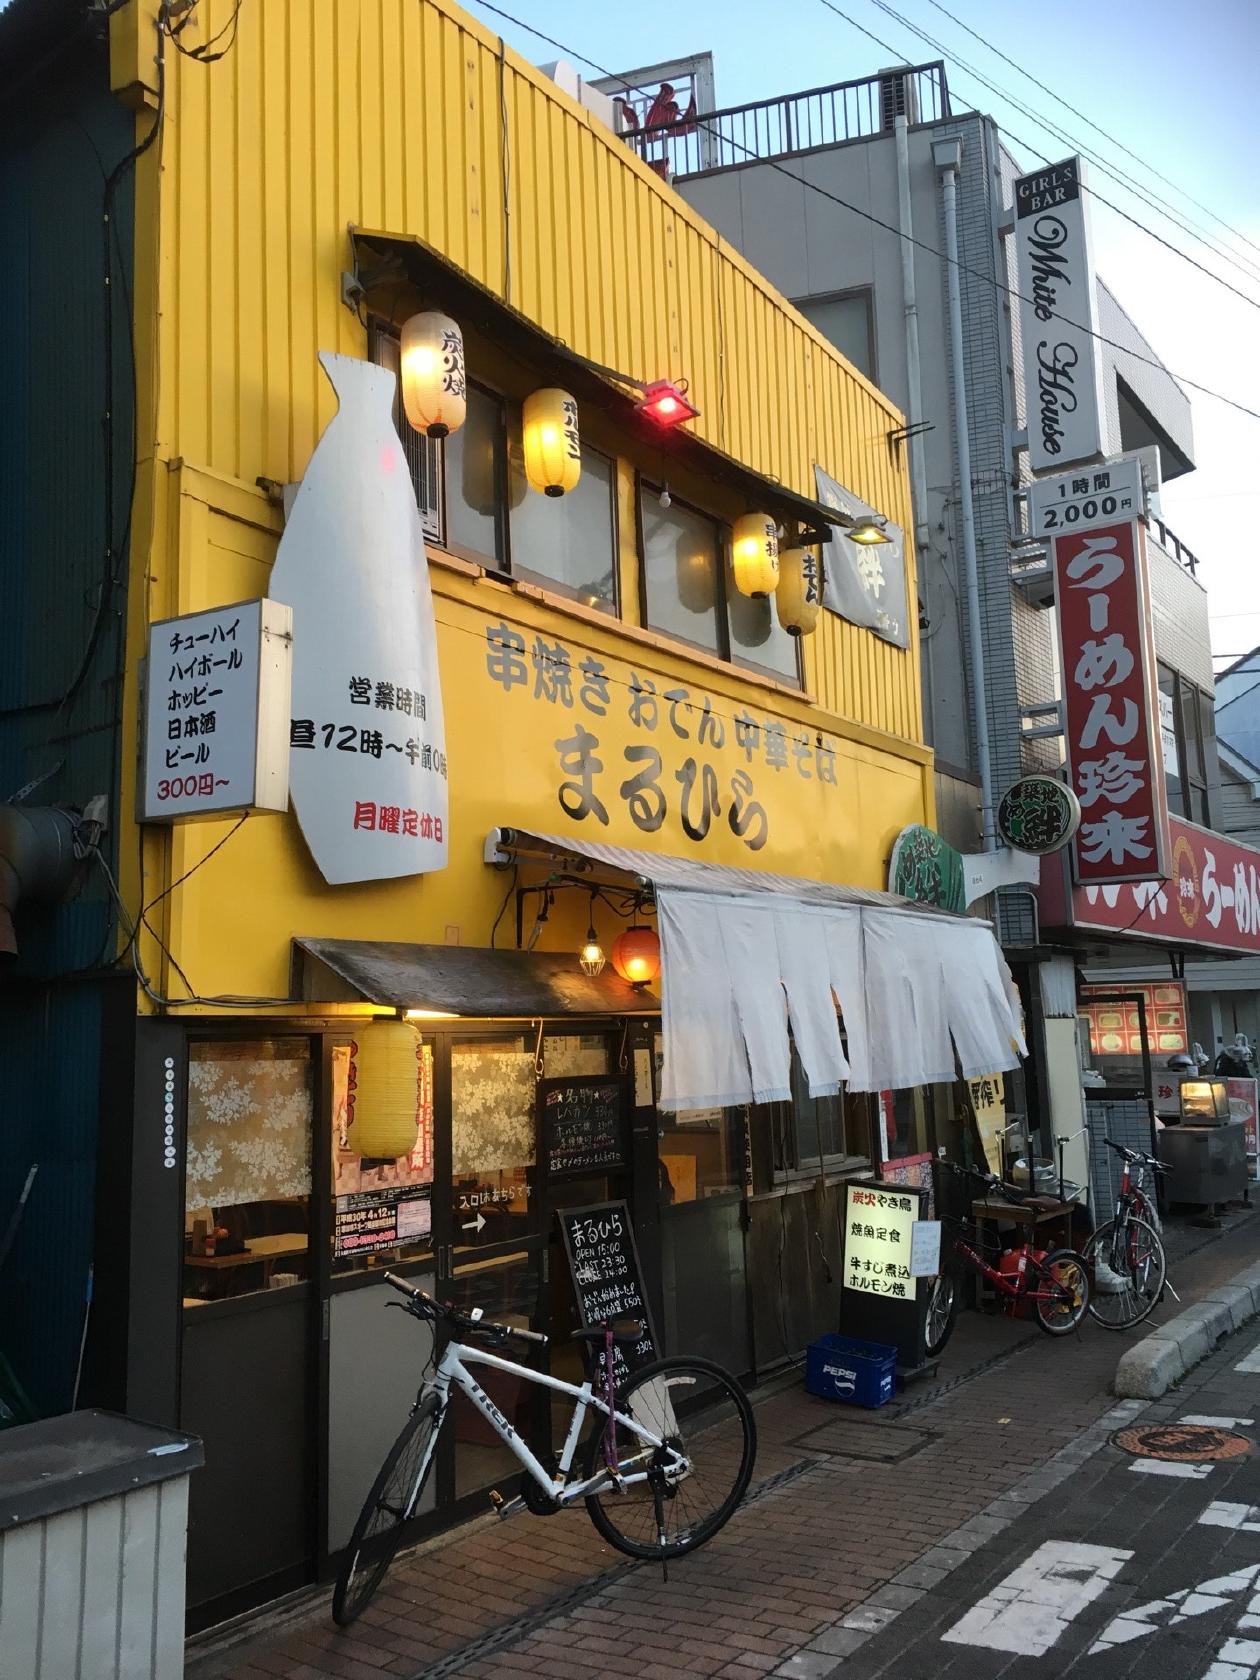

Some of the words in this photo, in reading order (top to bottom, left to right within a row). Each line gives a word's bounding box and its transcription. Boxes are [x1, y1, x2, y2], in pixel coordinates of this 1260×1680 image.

[1031, 187, 1066, 212] BAR
[1027, 214, 1071, 322] White
[1037, 340, 1078, 456] House
[1058, 472, 1110, 498] 1時間
[1044, 495, 1131, 529] 2,000円
[169, 619, 240, 655] チューハイ
[168, 649, 243, 681] ハイボール
[167, 683, 224, 711] ホッピー
[349, 676, 427, 721] 営業時間
[486, 622, 610, 716] 串焼き
[628, 671, 725, 749] おでん
[734, 708, 838, 785] 中華そば
[1066, 535, 1154, 865] らーめん珍来
[167, 711, 217, 740] 日本酒
[165, 743, 210, 768] ビール
[554, 723, 769, 851] まるひら
[353, 801, 443, 843] 月曜定休日
[459, 1184, 533, 1210] 入口はあちらです
[852, 1191, 912, 1212] 炭火やき鳥
[571, 1214, 623, 1248] まるひら
[850, 1221, 902, 1243] 焼魚定食
[575, 1247, 595, 1261] OPEN
[601, 1255, 626, 1268] 23:30
[850, 1275, 906, 1297] ホルモン焼
[823, 1364, 857, 1380] PEPSI
